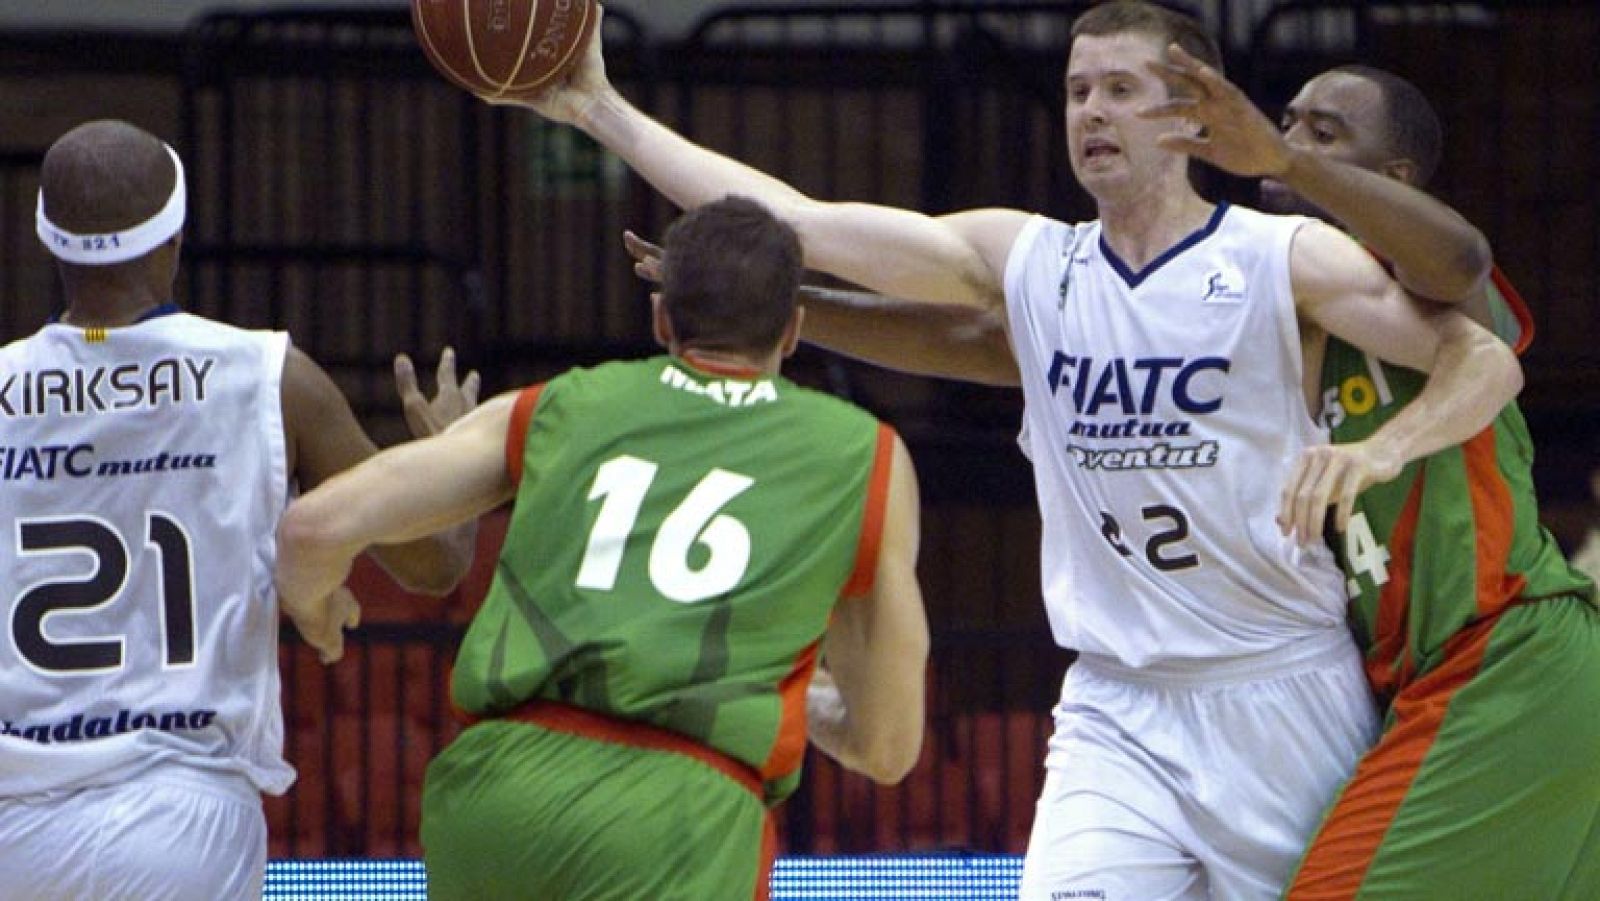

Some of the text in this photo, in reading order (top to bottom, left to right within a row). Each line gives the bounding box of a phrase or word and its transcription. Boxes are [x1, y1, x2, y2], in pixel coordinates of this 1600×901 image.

[0, 357, 215, 416] KIRKSAY
[1047, 350, 1232, 416] FIATC
[1068, 418, 1192, 438] mutua
[0, 443, 217, 480] IATC mutua
[575, 455, 756, 604] 16
[1347, 511, 1391, 599] 4
[11, 512, 197, 674] 21
